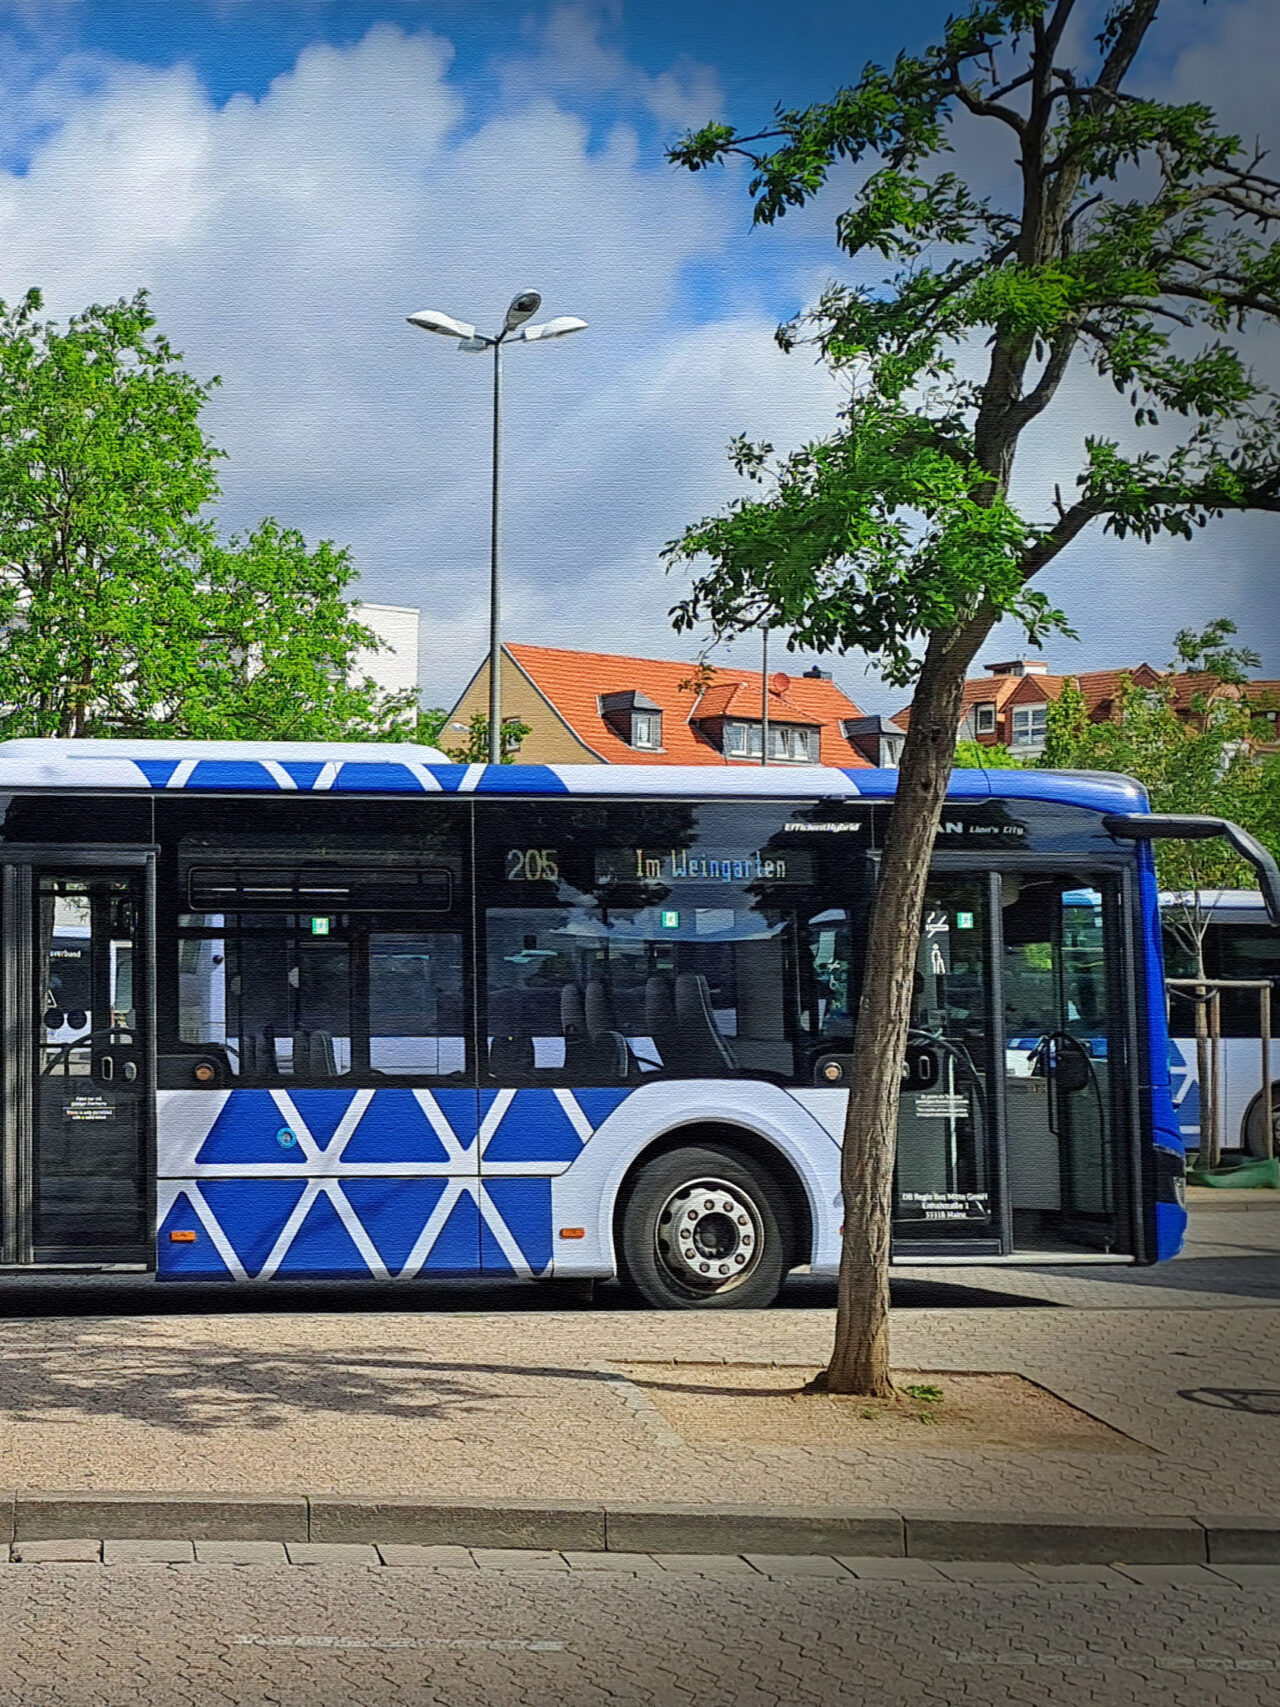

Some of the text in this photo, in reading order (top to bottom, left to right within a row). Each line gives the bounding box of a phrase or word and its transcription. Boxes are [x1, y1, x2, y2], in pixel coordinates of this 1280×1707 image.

[1002, 826, 1024, 836] City
[507, 849, 559, 881] 205
[636, 849, 786, 883] Im Weingarten
